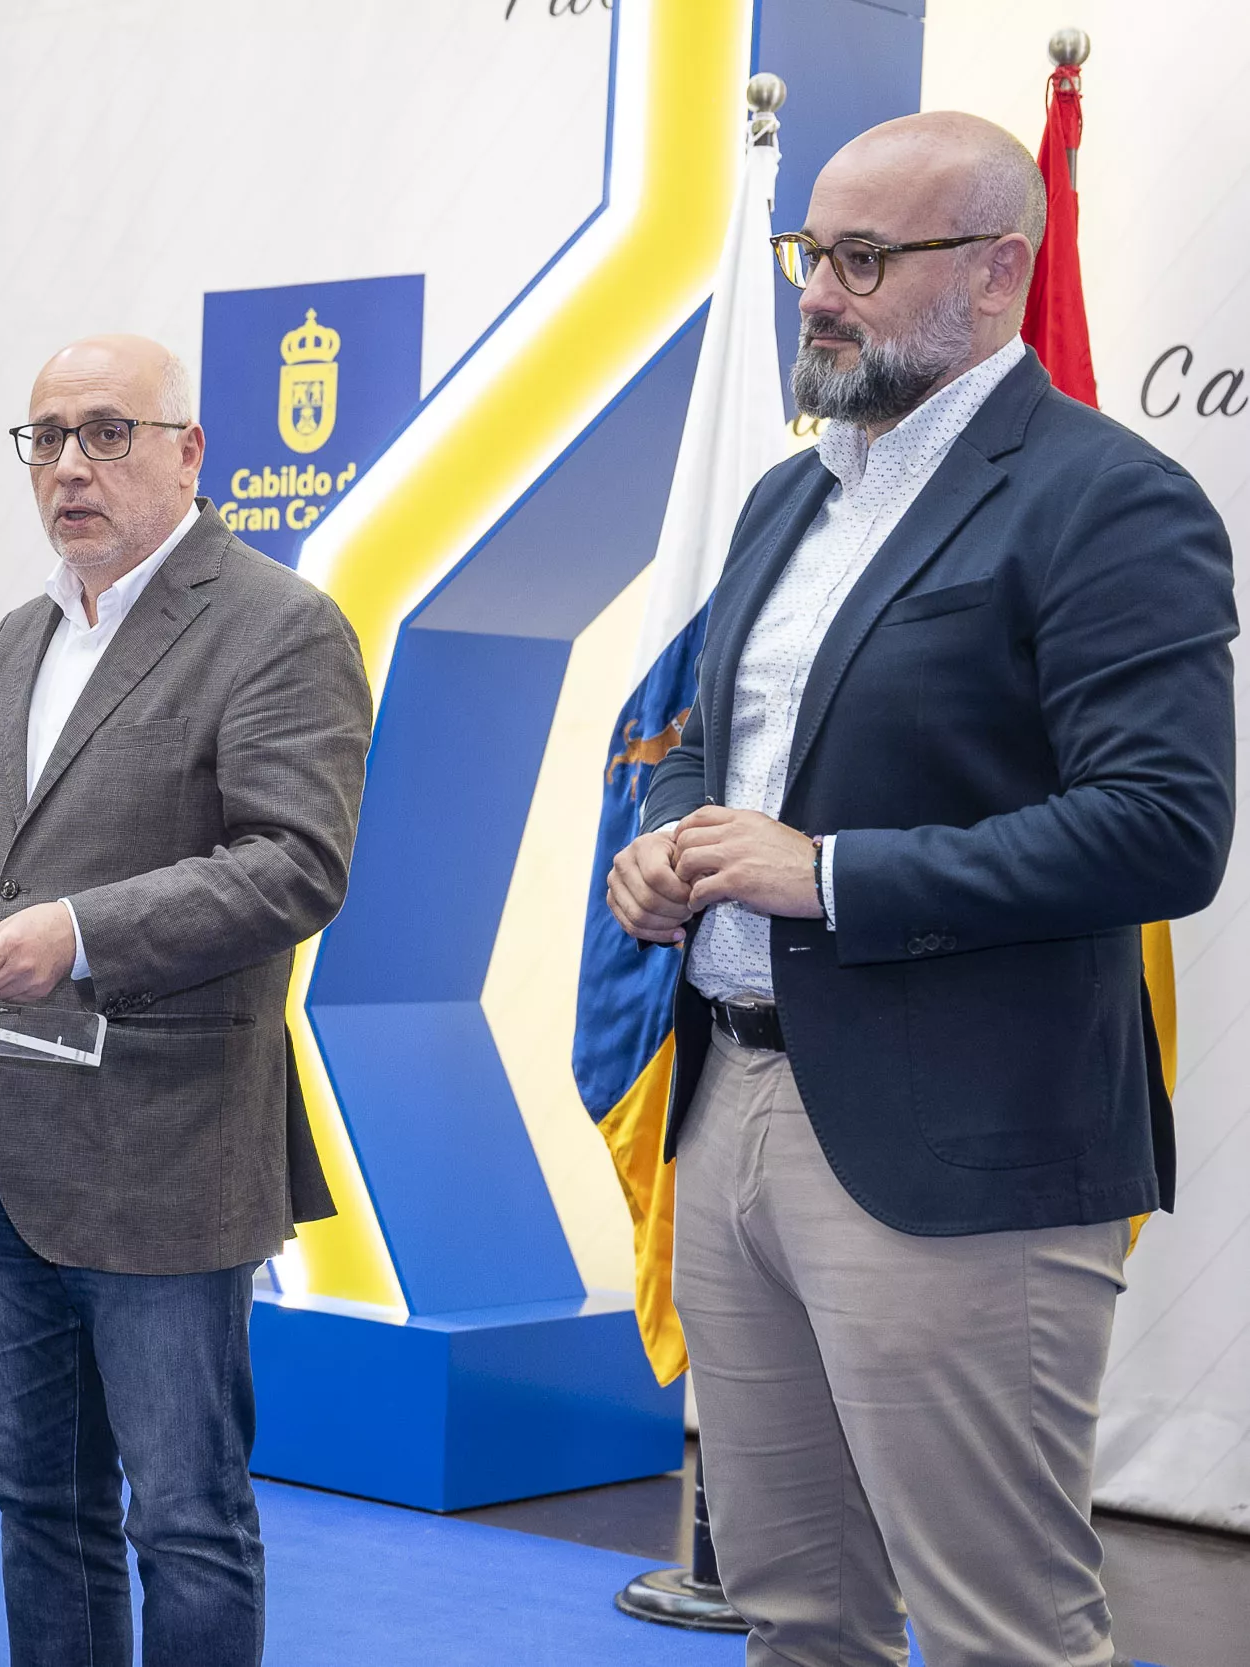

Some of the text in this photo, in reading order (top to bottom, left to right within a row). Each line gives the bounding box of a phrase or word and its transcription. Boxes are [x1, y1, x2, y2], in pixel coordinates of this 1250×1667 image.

[231, 462, 357, 499] Cabildo d
[219, 498, 326, 532] Gran Ca
